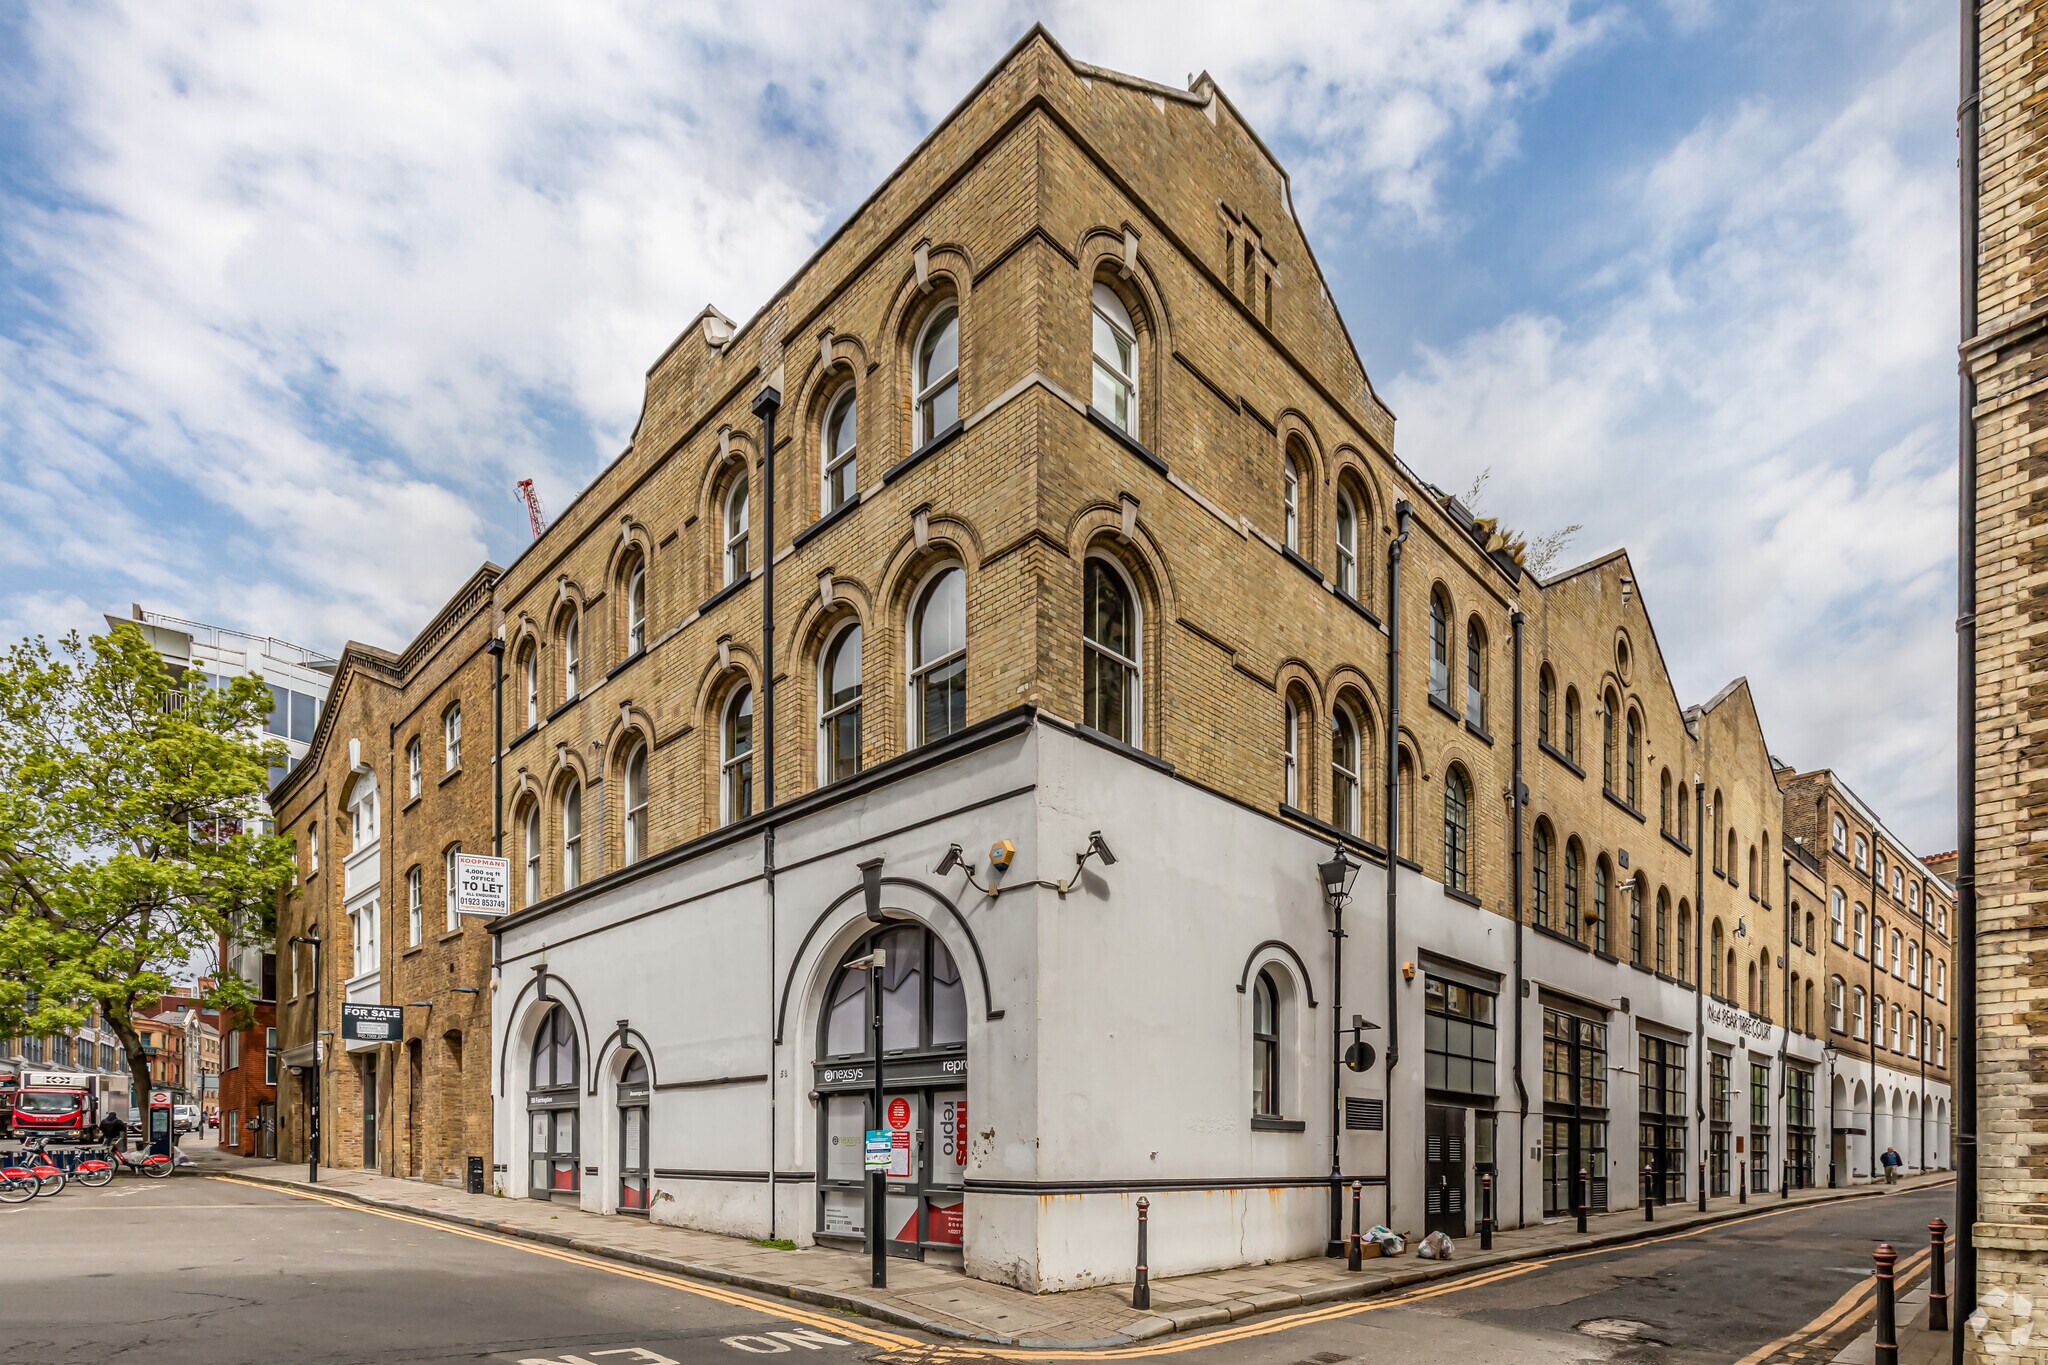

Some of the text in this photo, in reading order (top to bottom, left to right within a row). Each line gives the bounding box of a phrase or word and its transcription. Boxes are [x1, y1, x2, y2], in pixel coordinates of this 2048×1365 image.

[460, 858, 505, 867] KOOPMANS
[462, 881, 504, 893] TO LET
[461, 897, 480, 906] 01923
[371, 1010, 400, 1018] SALE
[940, 1101, 954, 1156] repro
